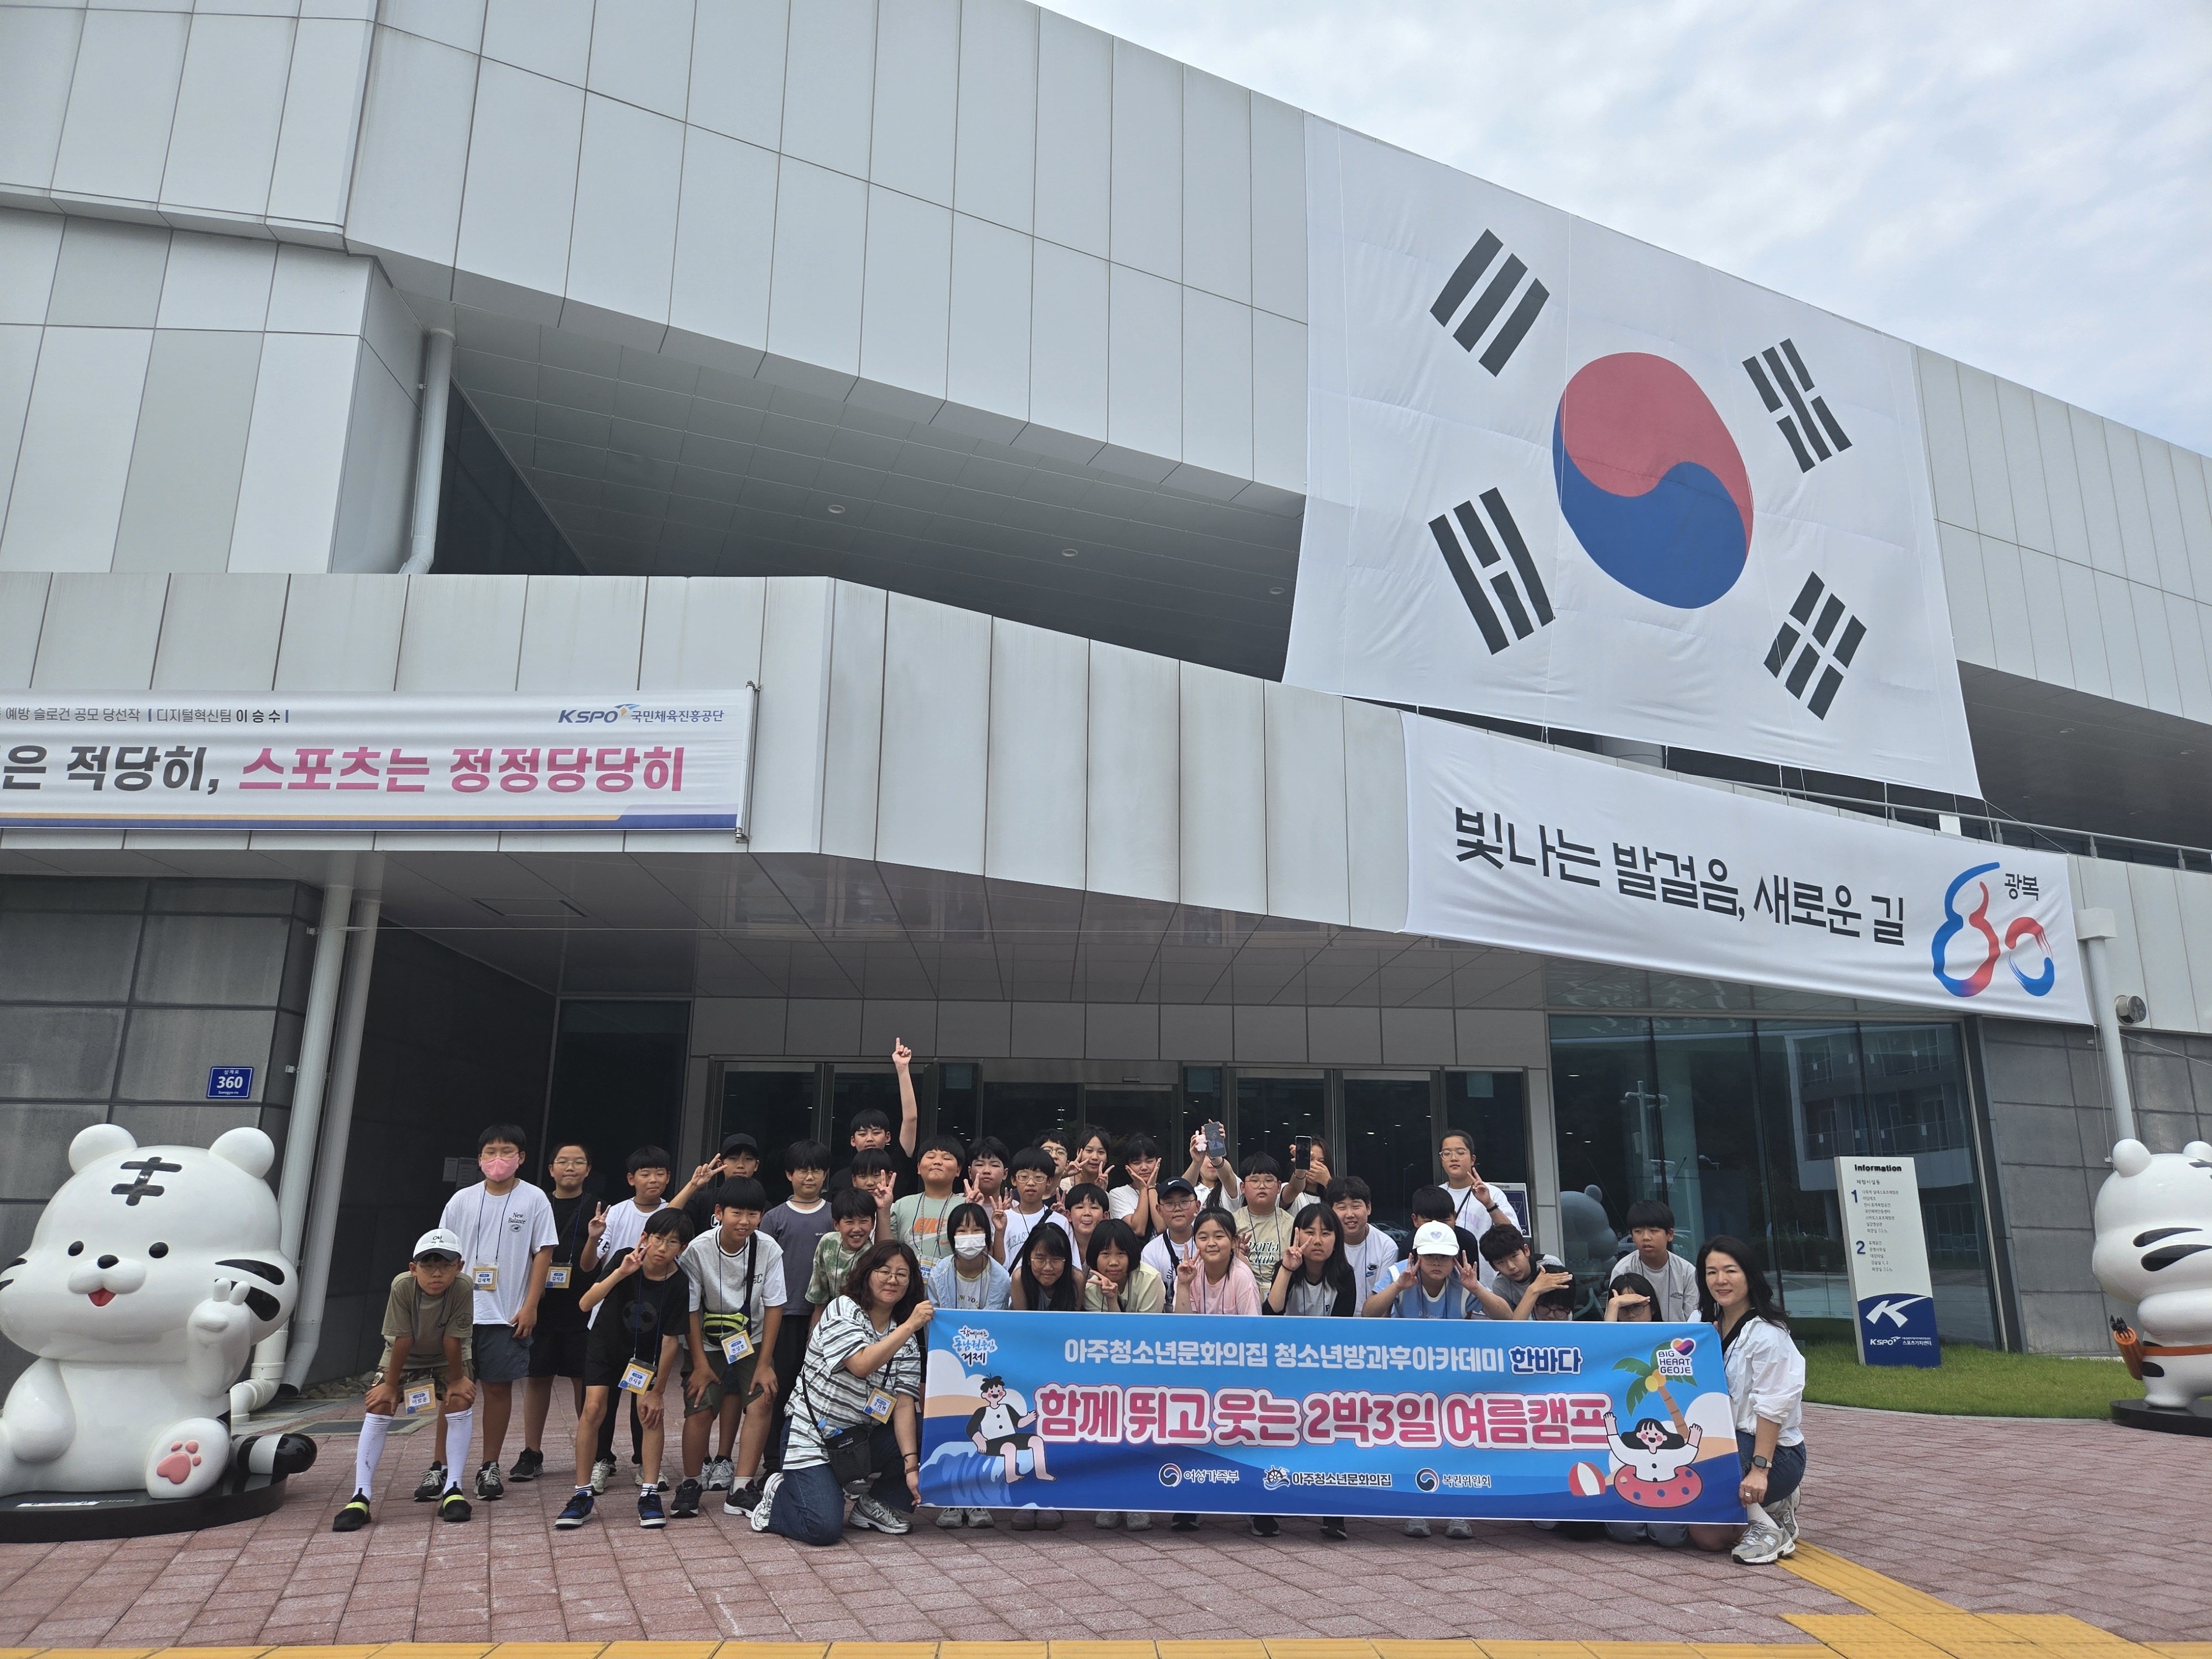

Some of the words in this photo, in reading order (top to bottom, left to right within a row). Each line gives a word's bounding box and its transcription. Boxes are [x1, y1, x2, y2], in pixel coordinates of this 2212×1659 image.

[6, 707, 30, 721] 예방
[34, 707, 70, 721] 슬로건
[75, 708, 99, 722] 공모
[103, 708, 140, 722] 당선작
[156, 708, 231, 723] 디지털혁신팀
[558, 709, 618, 724] KSPO
[631, 709, 724, 723] 국민체육진흥공단
[66, 745, 220, 795] 적당히,
[239, 746, 430, 792] 스포츠는
[450, 746, 685, 793] 정정당당히
[1455, 806, 1600, 887] 빛나는
[1613, 842, 1745, 922] 발걸음,
[1754, 875, 1861, 938] 새로운
[1871, 895, 1905, 946] 길
[2004, 873, 2039, 901] 광복
[216, 1076, 243, 1088] 360
[1851, 1190, 1858, 1203] 1
[1856, 1240, 1866, 1254] 2
[961, 1352, 985, 1365] 거제
[1064, 1338, 1268, 1368] 아주청소년문화의집
[1274, 1342, 1505, 1373] 청소년방과후아카데미
[1509, 1345, 1583, 1375] 한바다
[1039, 1388, 1119, 1438] 함께
[1127, 1390, 1209, 1441] 뛰고
[1215, 1392, 1297, 1442] 웃는
[1306, 1394, 1436, 1444] 2박3일
[1445, 1396, 1610, 1445] 여름캠프
[1183, 1469, 1240, 1484] 여성가족부
[1291, 1472, 1392, 1488] 아주청소년문화의집
[1442, 1473, 1491, 1489] 복권위원회
